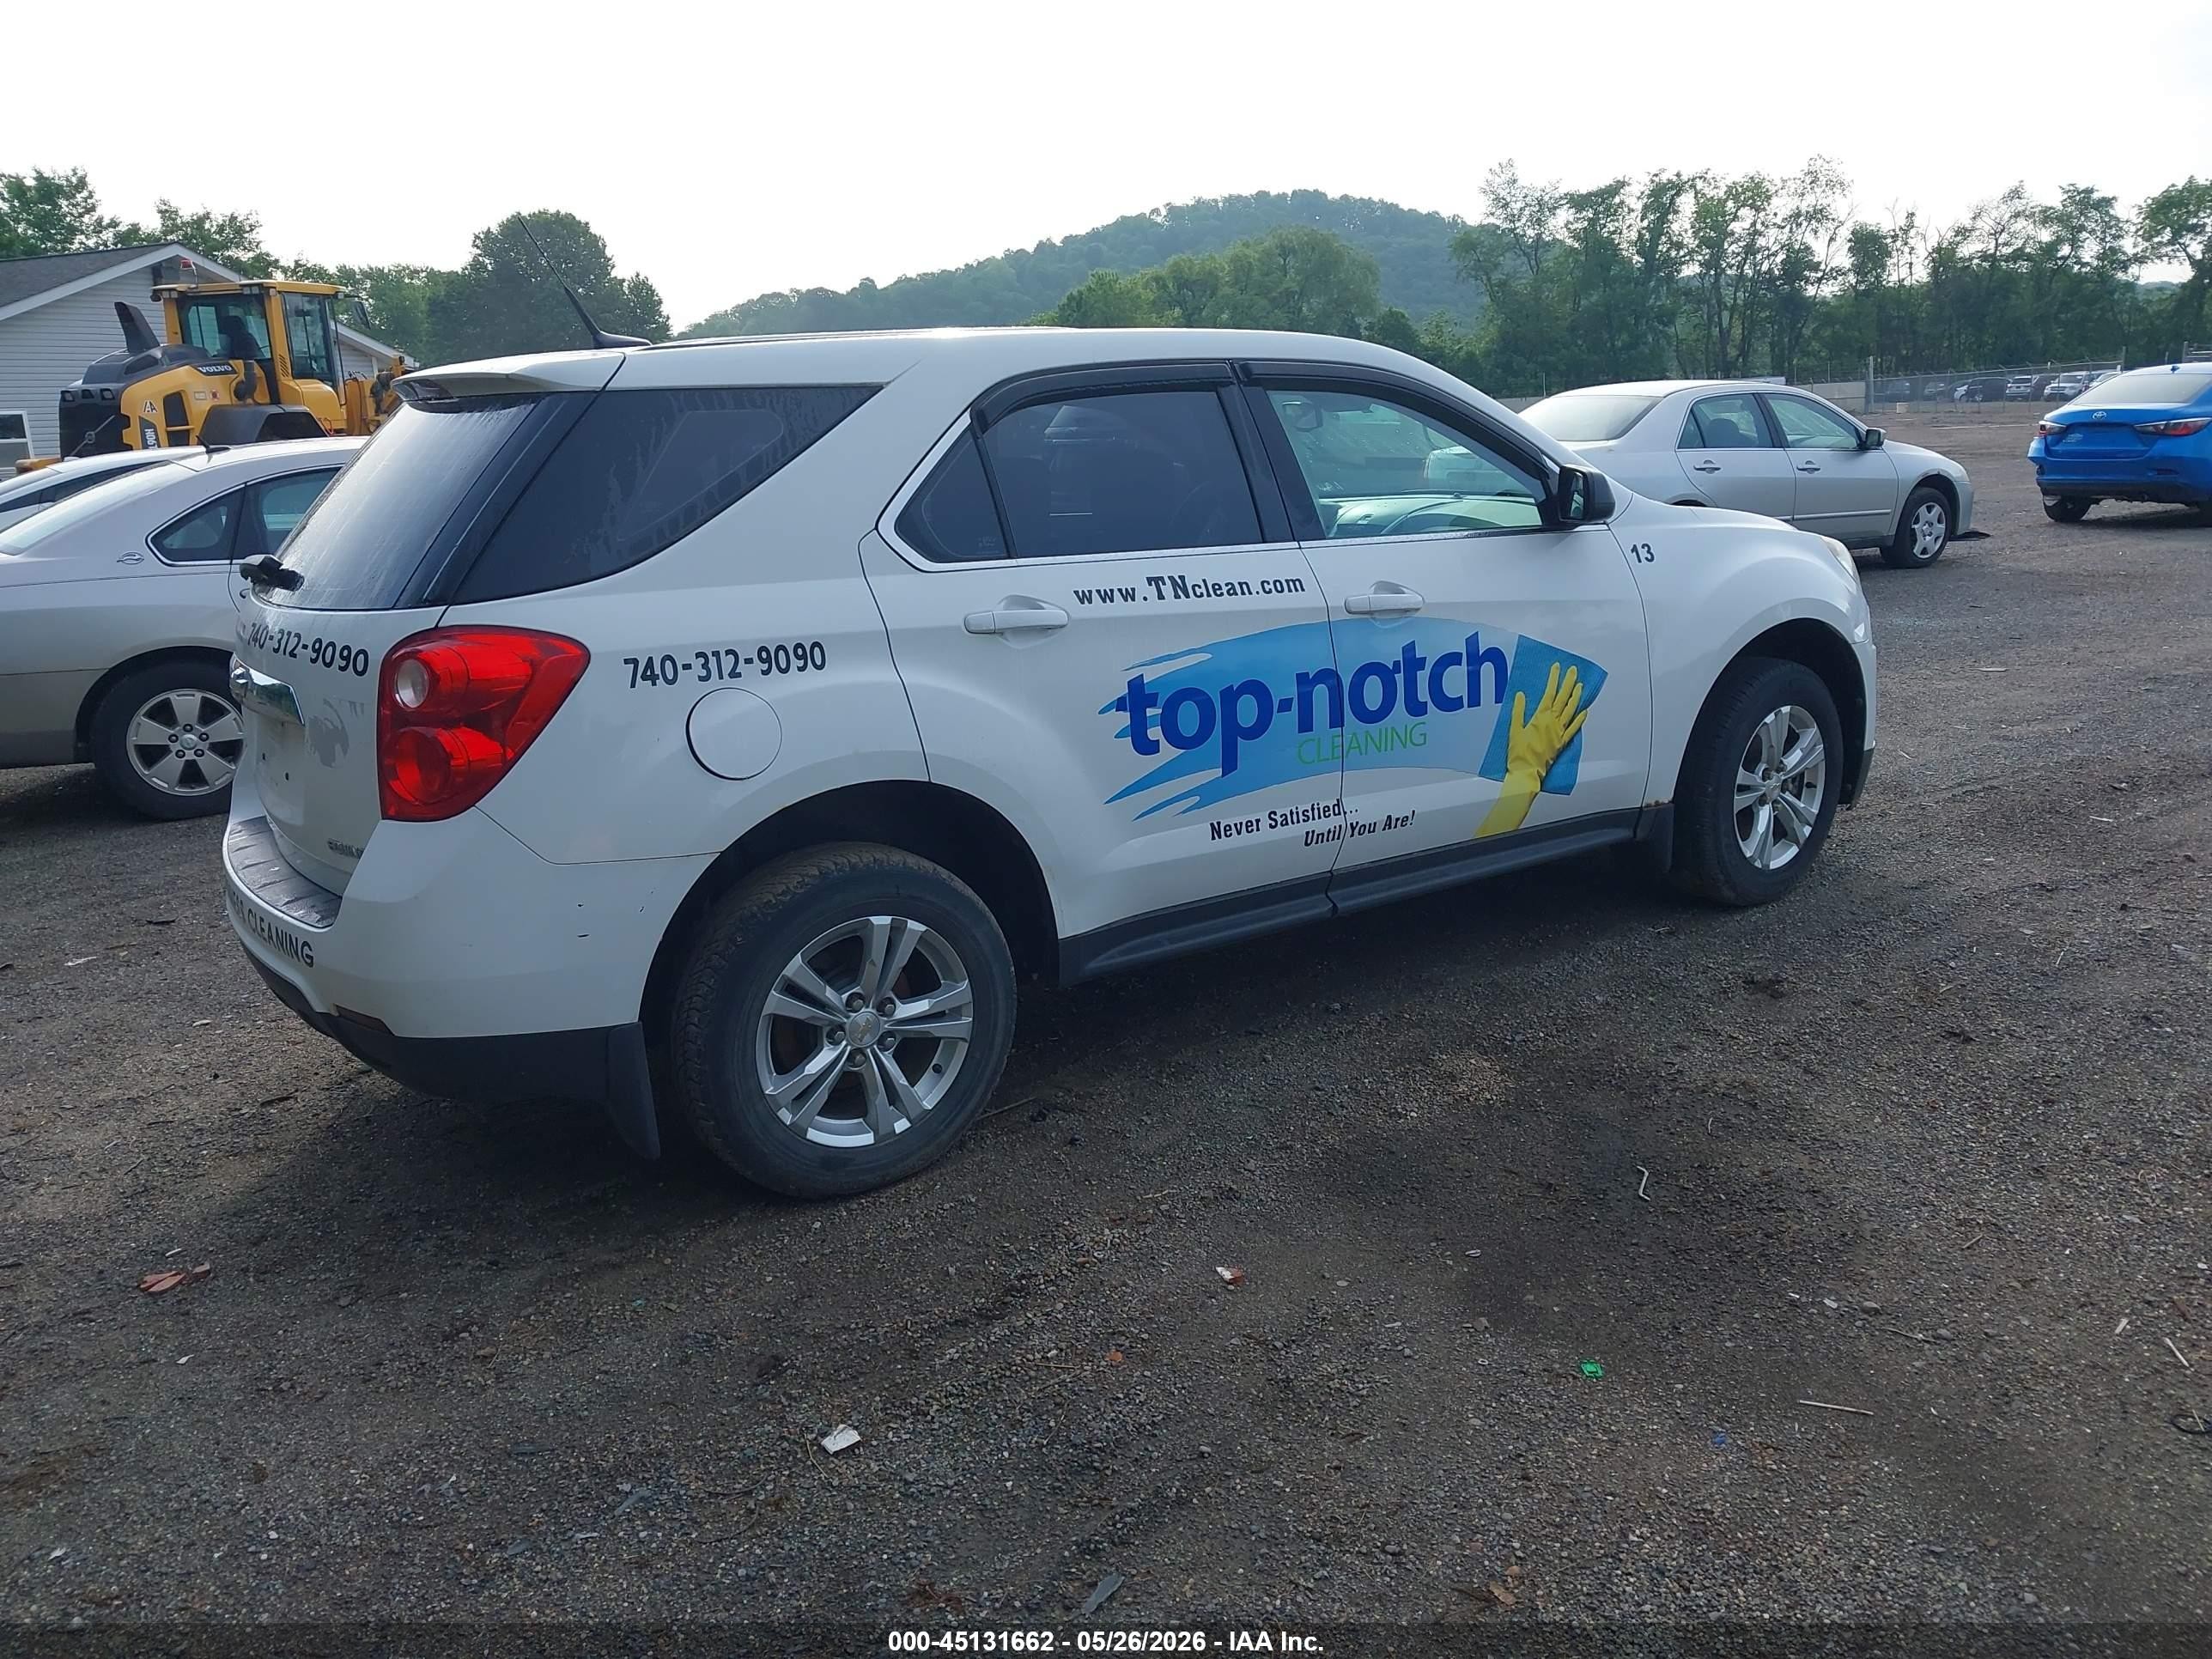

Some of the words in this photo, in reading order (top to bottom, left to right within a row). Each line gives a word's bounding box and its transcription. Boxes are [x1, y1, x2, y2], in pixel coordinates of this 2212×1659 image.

[198, 364, 233, 373] VOLVO
[1630, 543, 1655, 563] 13
[1073, 574, 1306, 605] www.TNclean.com
[247, 623, 369, 677] 740-312-9090
[623, 641, 826, 689] 740-312-9090
[1115, 631, 1509, 778] top-notch
[1297, 720, 1428, 766] CLEANING
[1209, 817, 1261, 842] Never
[1304, 823, 1343, 848] Until
[1348, 820, 1377, 838] You
[1381, 809, 1417, 832] Are!
[247, 908, 314, 969] CLEANING
